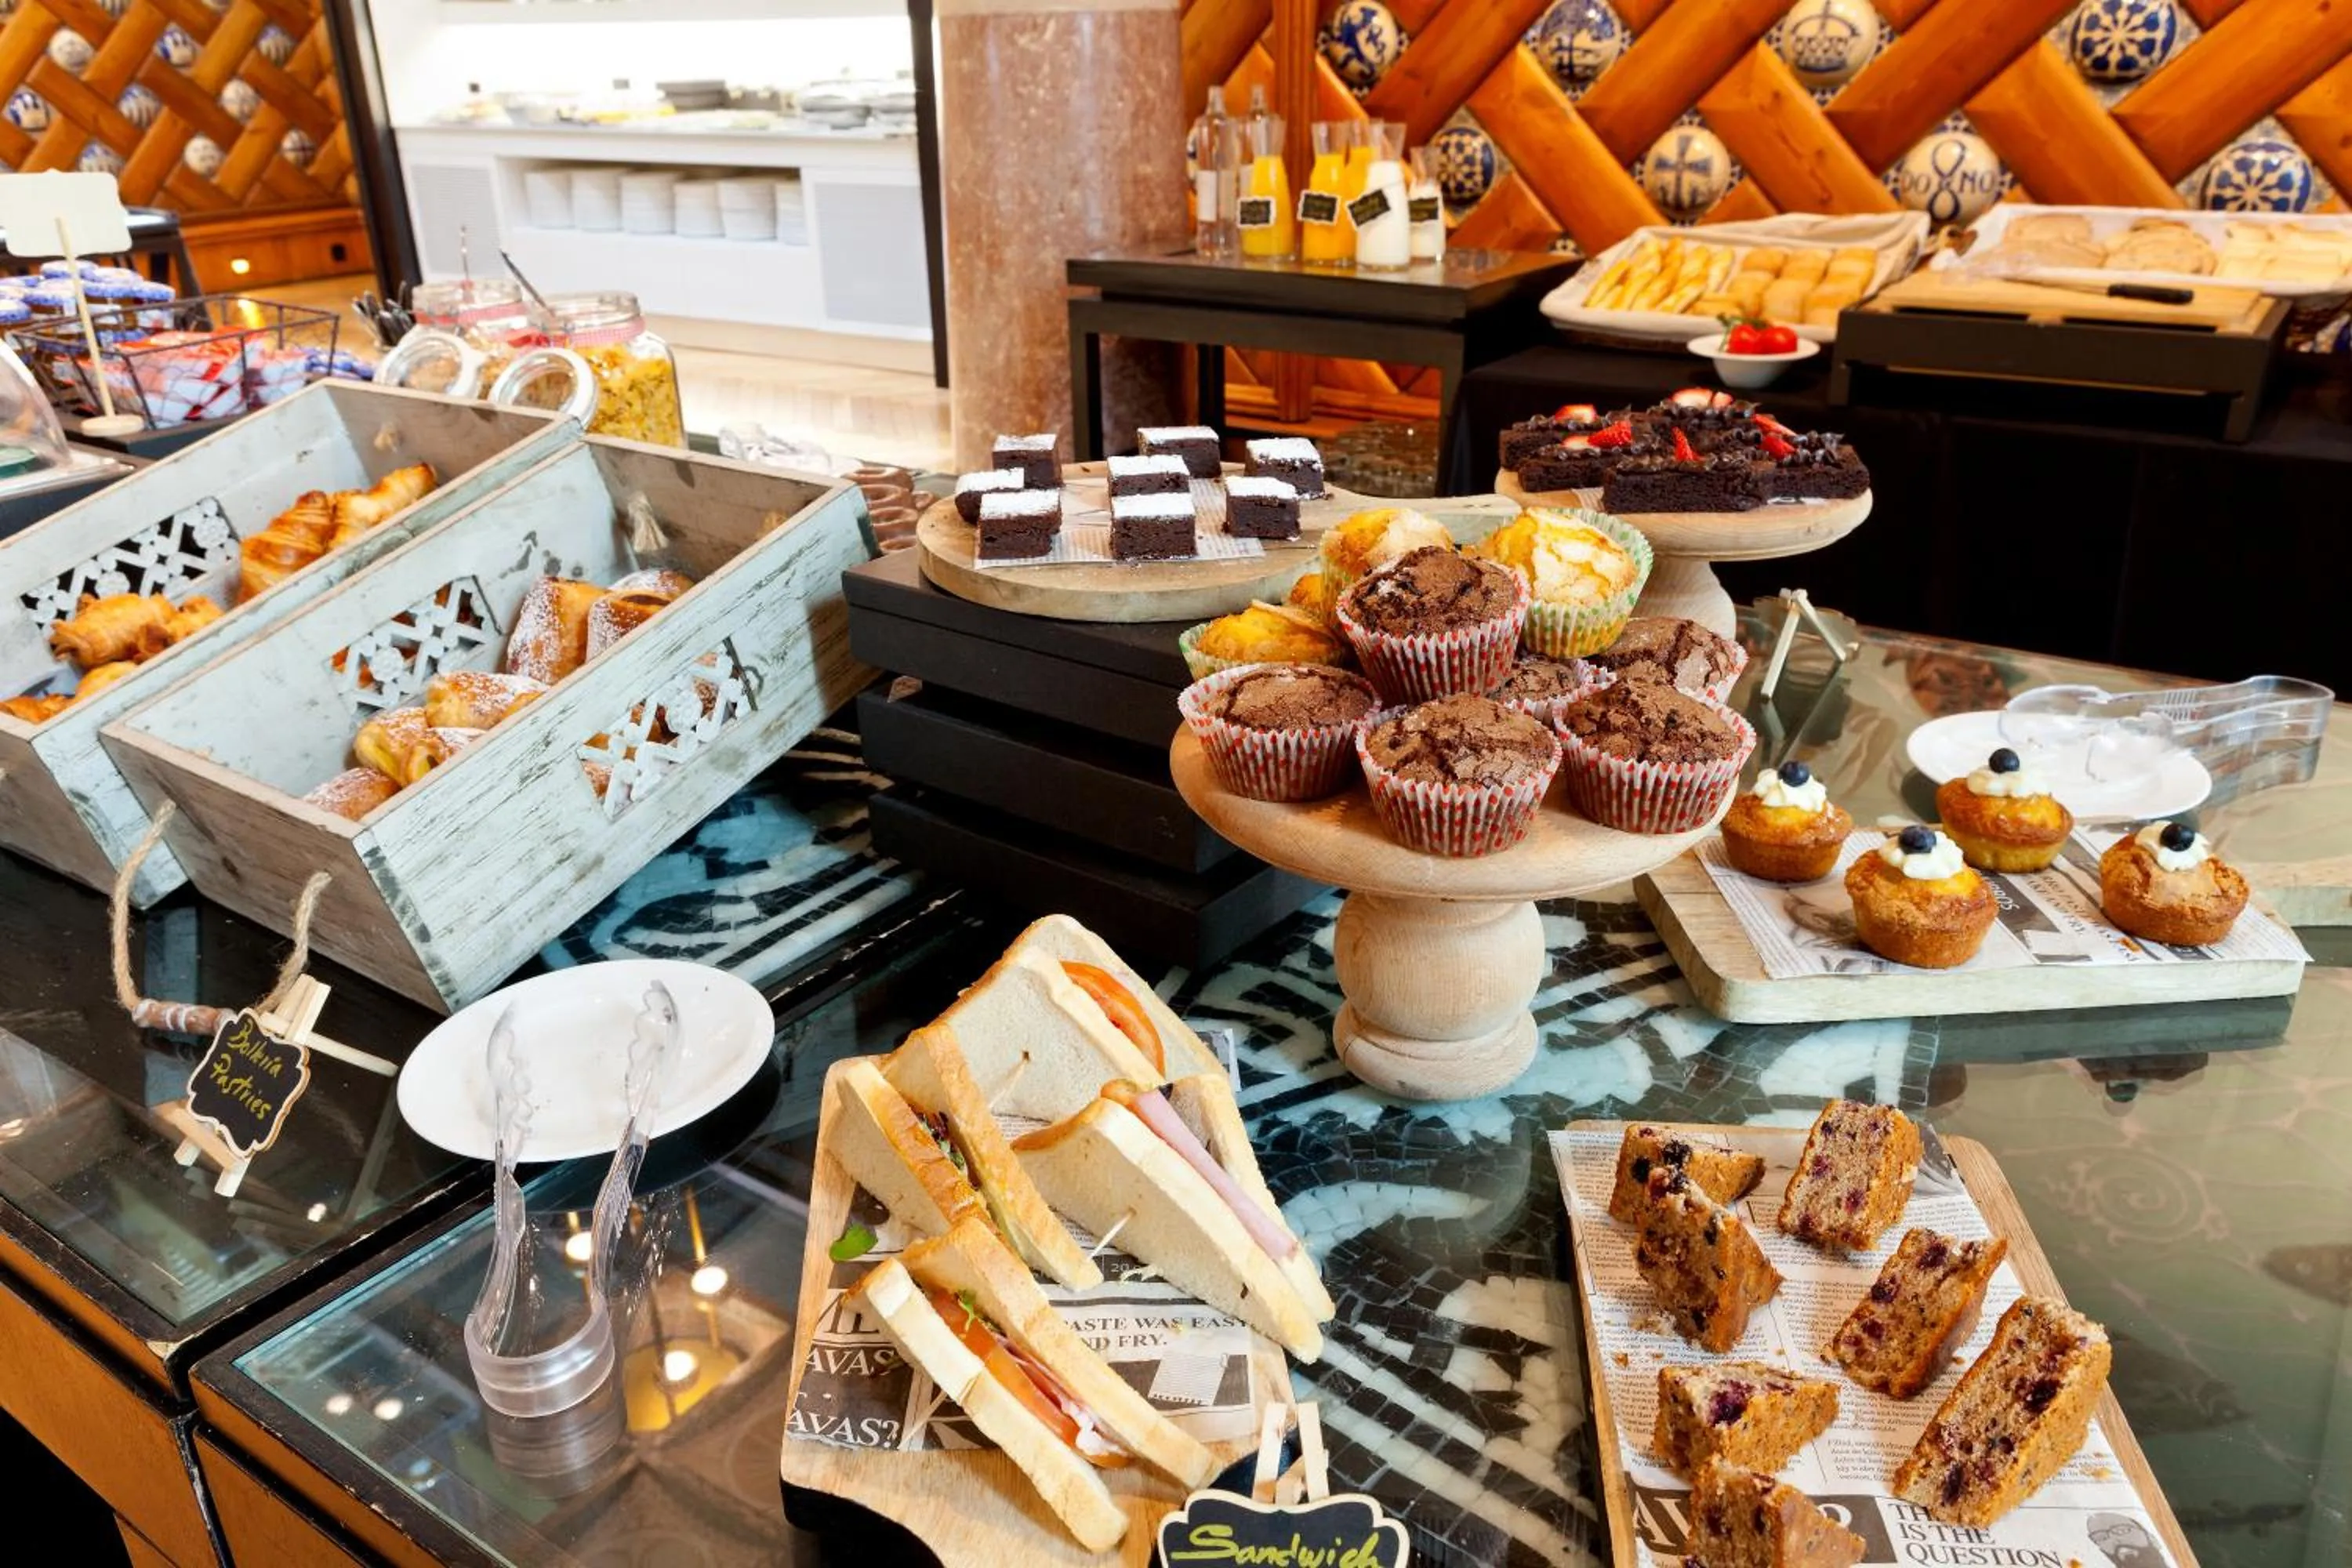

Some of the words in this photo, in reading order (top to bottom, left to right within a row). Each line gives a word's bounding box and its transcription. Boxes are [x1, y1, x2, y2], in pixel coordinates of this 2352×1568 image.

[209, 1053, 272, 1120] Pastries
[1064, 1316, 1127, 1332] ASTE
[1134, 1316, 1184, 1330] WAS
[1080, 1334, 1112, 1352] ND
[1118, 1332, 1168, 1348] FRY.
[1171, 1523, 1385, 1568] Sandwich
[1897, 1522, 1927, 1541] IS
[1928, 1524, 1996, 1545] THE
[1906, 1541, 2062, 1568] QUESTION
